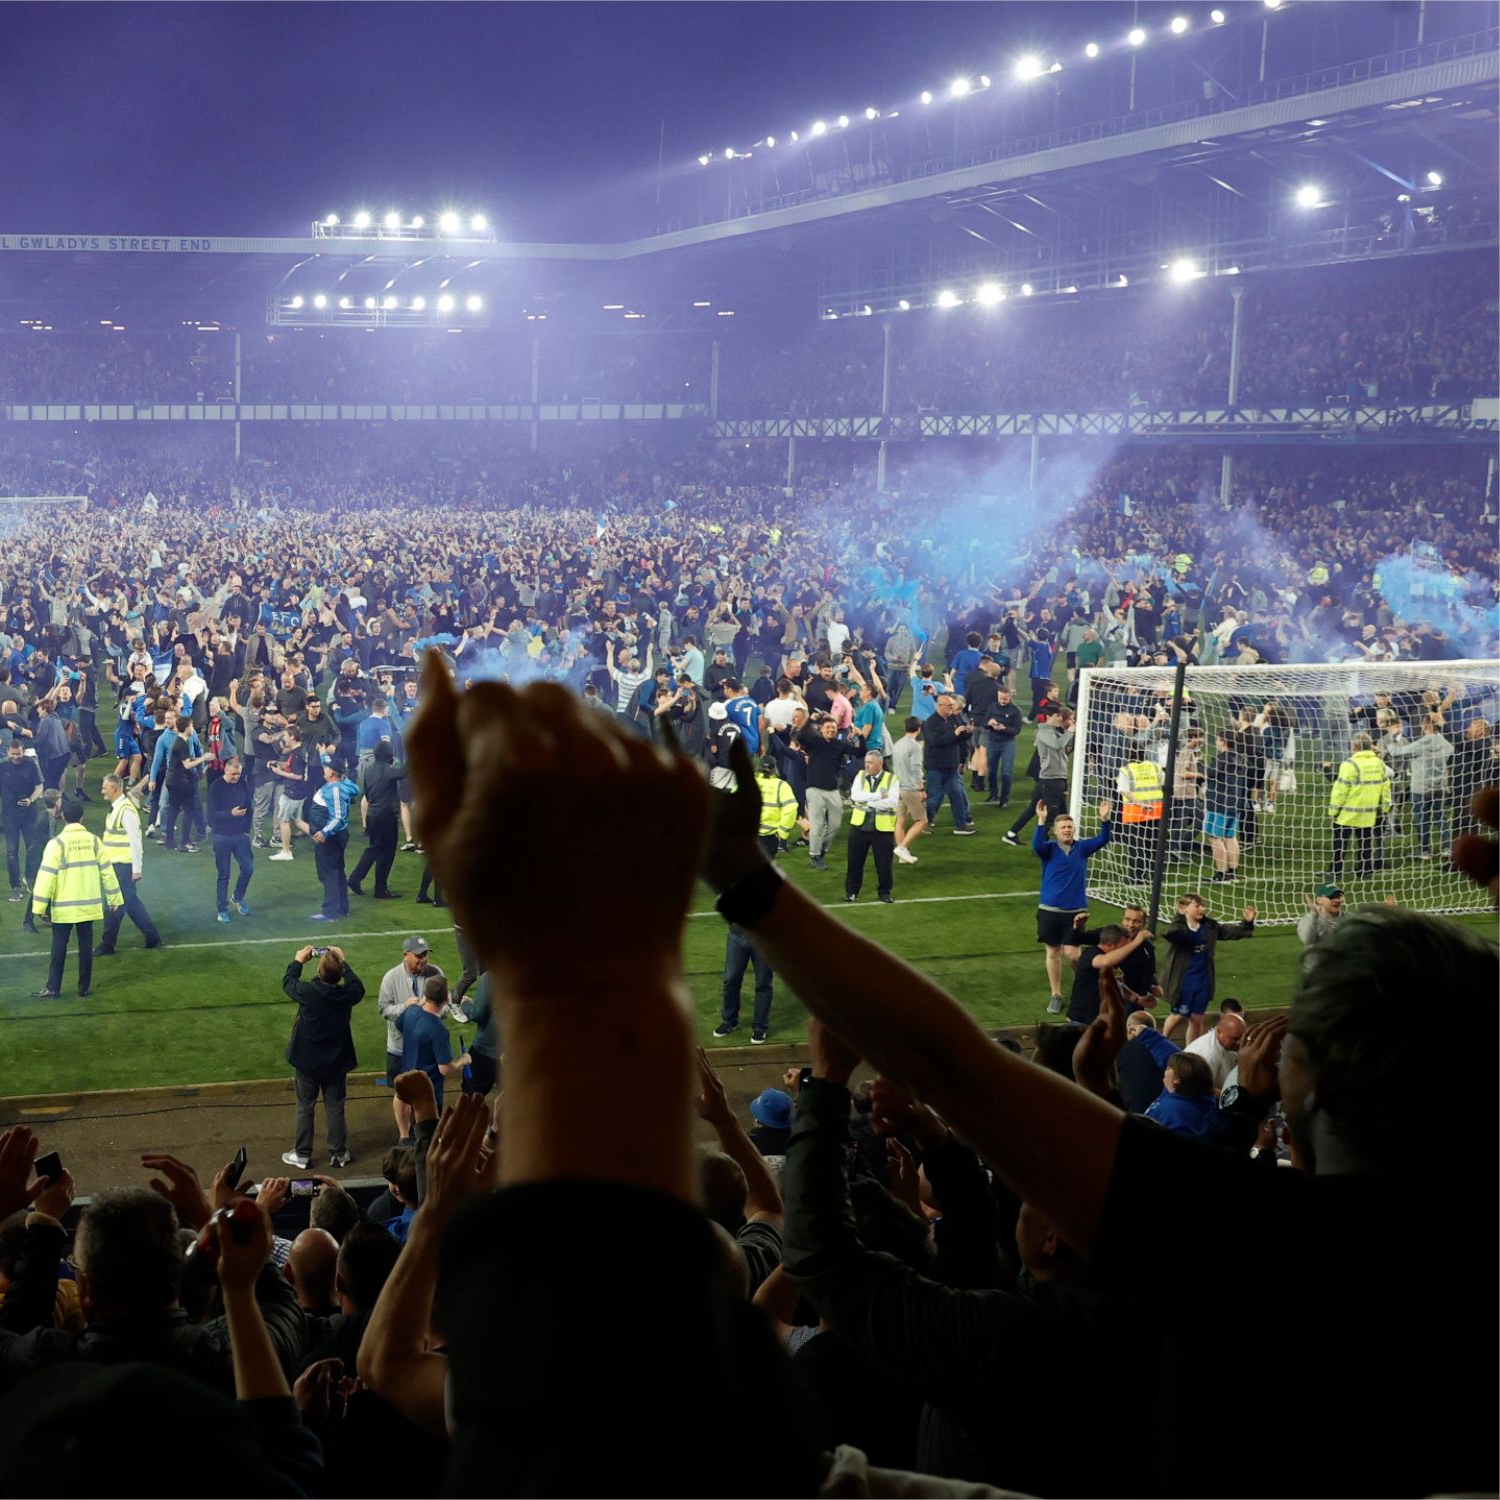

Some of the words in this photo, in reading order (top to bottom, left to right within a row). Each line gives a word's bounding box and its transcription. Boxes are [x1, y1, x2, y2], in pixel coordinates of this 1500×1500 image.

[20, 237, 100, 250] GWLADYS
[108, 238, 170, 250] STREET
[180, 239, 212, 251] END
[271, 611, 300, 627] EFC
[742, 706, 753, 727] 7
